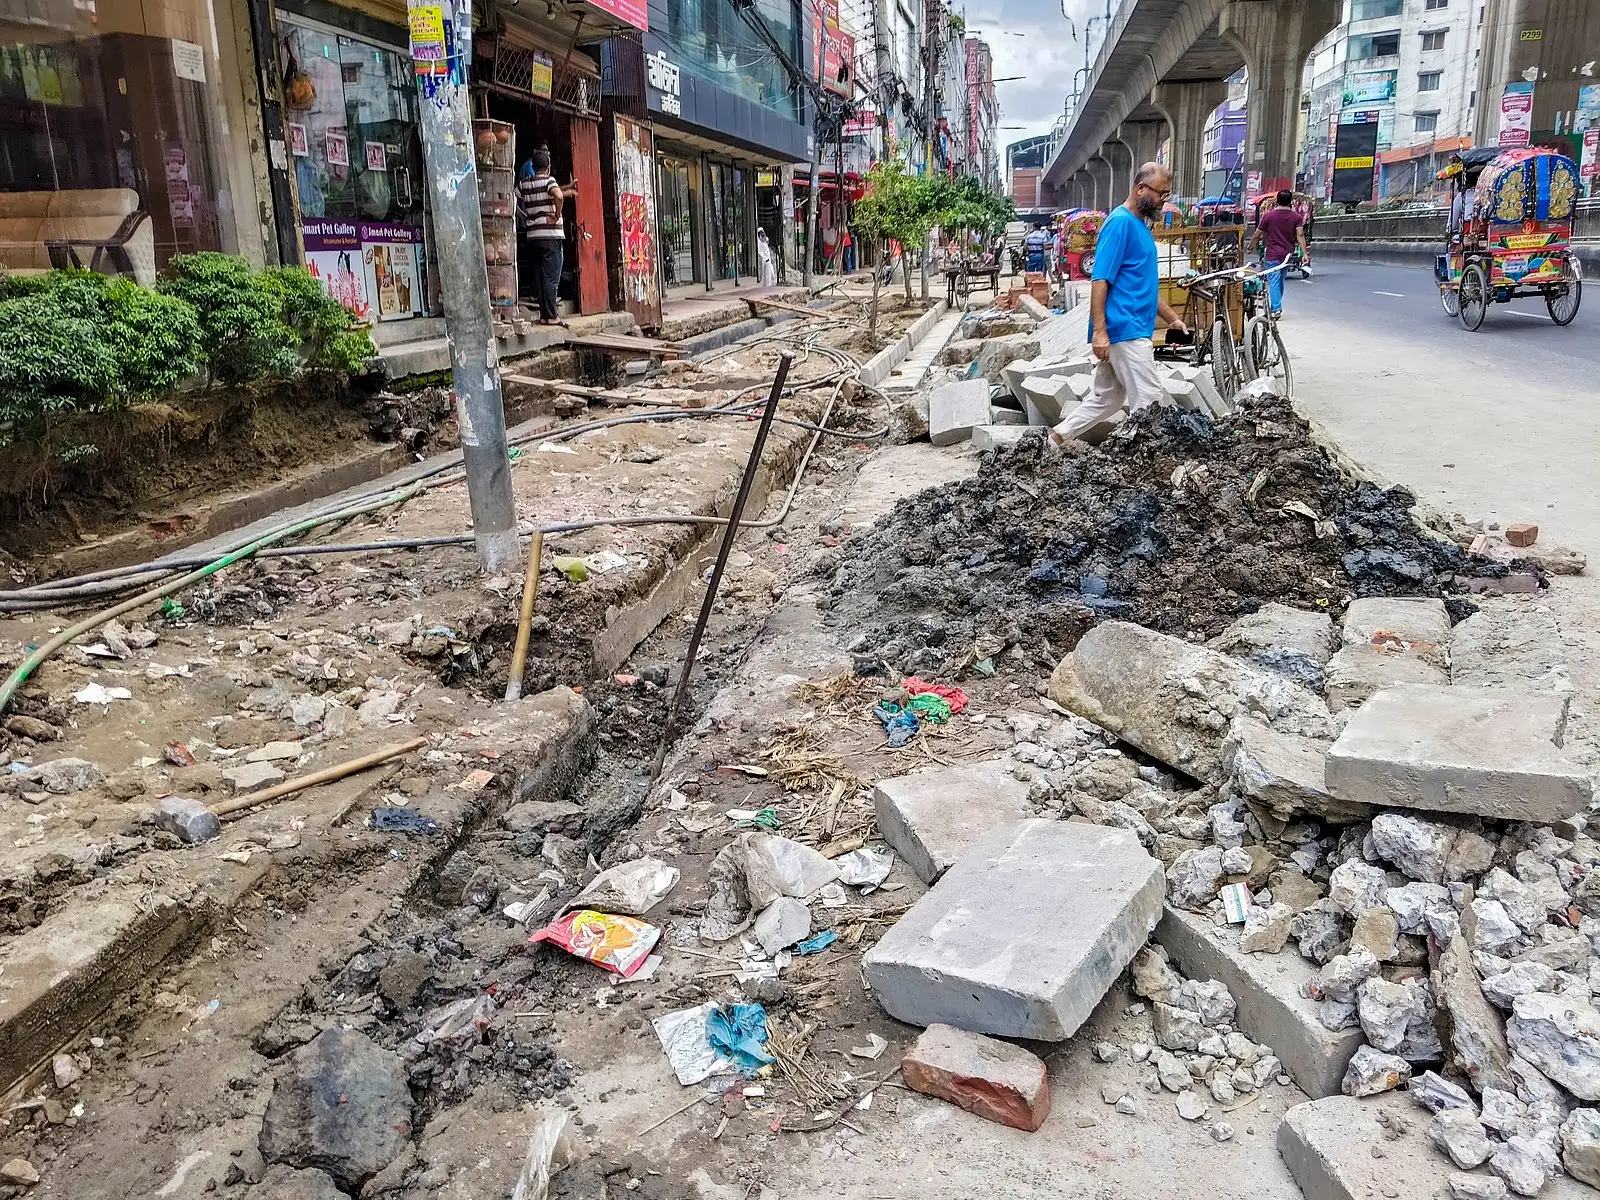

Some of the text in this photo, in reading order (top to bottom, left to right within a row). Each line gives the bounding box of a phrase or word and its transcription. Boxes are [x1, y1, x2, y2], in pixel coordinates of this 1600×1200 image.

[321, 223, 333, 235] Pet
[334, 223, 356, 237] Gallery
[368, 227, 412, 240] Smart Pet Gallery
